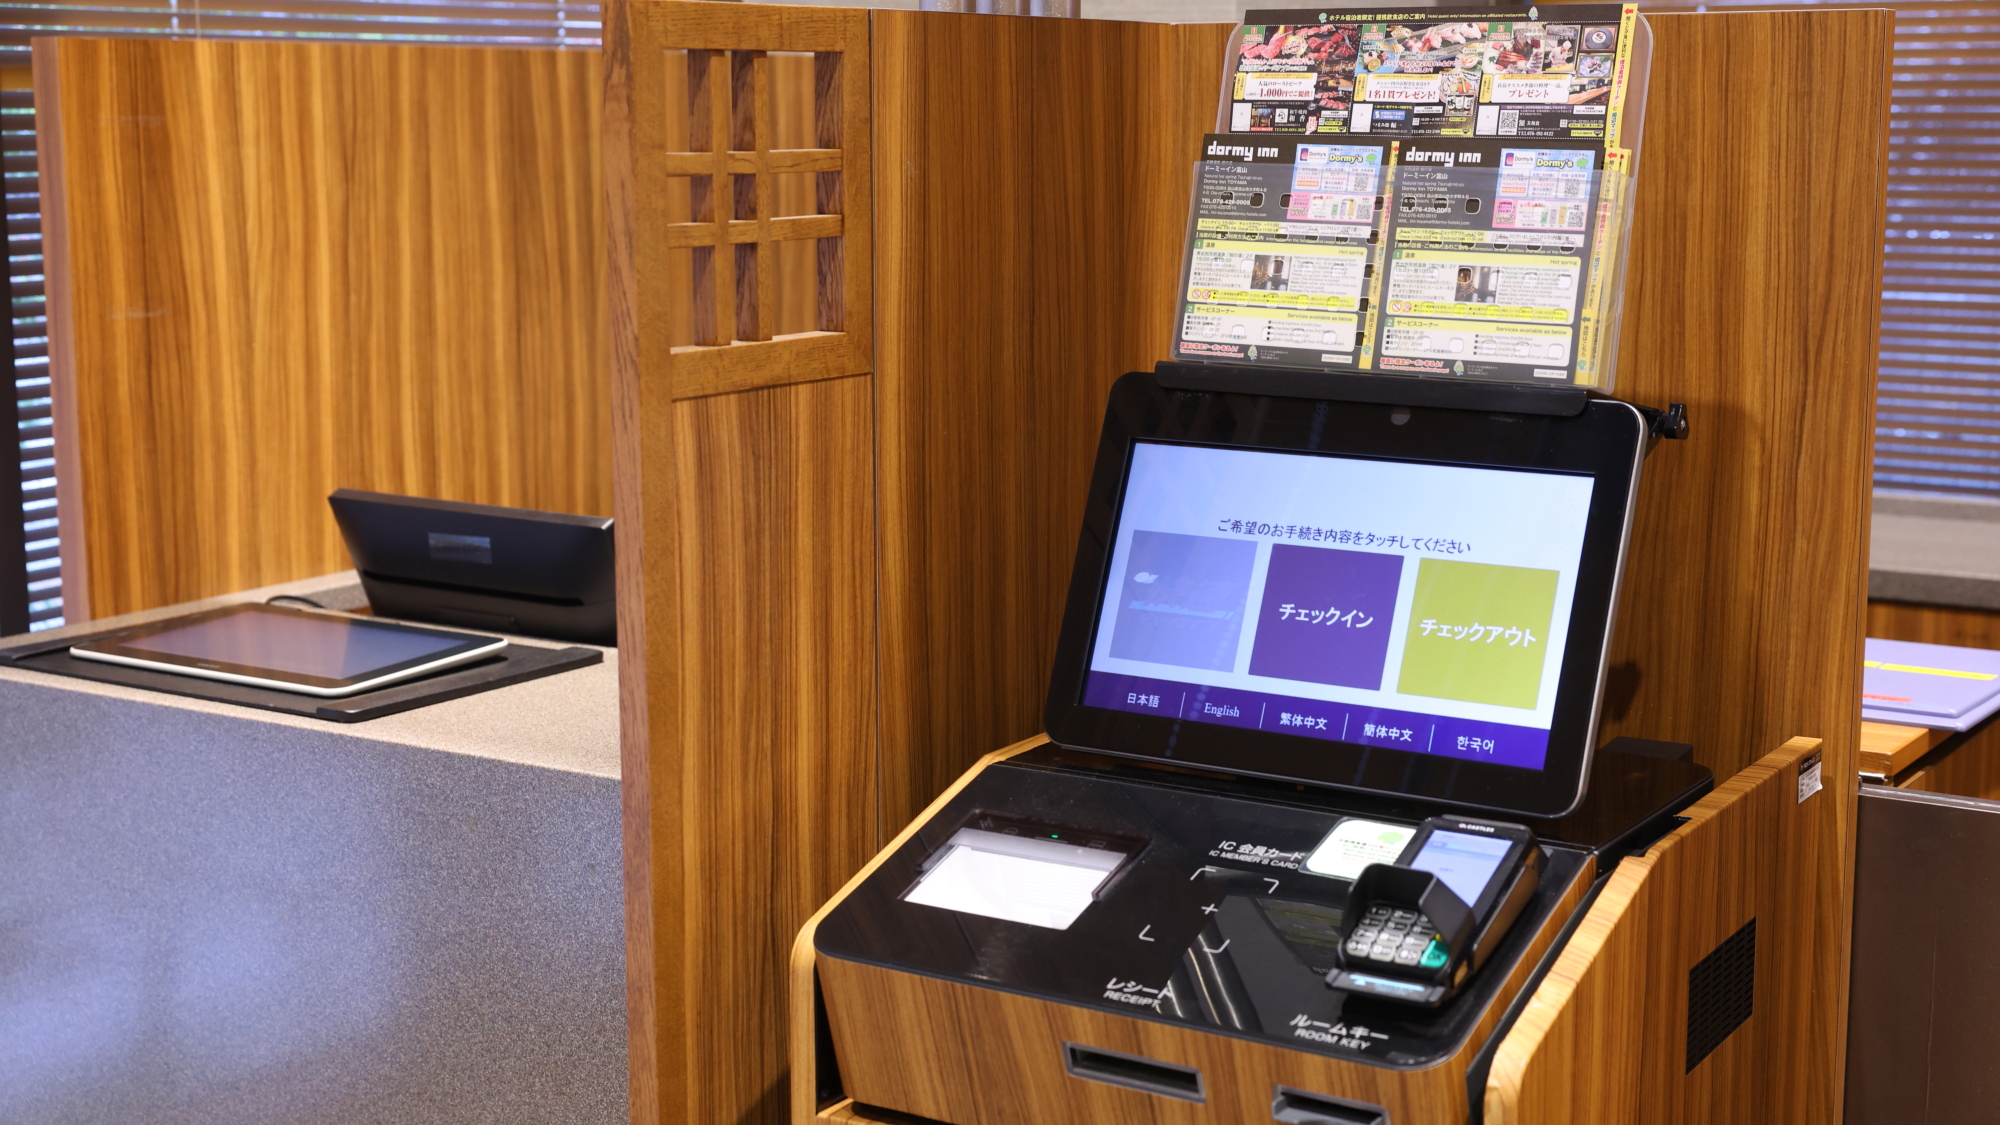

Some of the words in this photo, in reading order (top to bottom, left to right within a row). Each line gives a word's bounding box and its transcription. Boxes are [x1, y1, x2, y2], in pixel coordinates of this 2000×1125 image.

[1368, 90, 1436, 100] 1名1貫プレゼント!
[1509, 90, 1549, 98] プレゼント
[1207, 141, 1254, 161] dormy
[1329, 154, 1363, 163] Dormy's
[1406, 147, 1454, 167] dormy
[1536, 158, 1573, 168] Dormy's
[1403, 172, 1448, 180] ドーミーイン富山
[1218, 519, 1471, 554] ご希望のお手続き内容をタッチしてください
[1279, 603, 1374, 629] チェックイン
[1419, 618, 1537, 648] チェックアウト
[1127, 693, 1160, 708] 日本語
[1204, 703, 1240, 717] English
[1280, 712, 1328, 731] 繁体中文
[1364, 723, 1413, 742] 簡体中文
[1457, 735, 1495, 754] 한국어
[1218, 840, 1237, 850] IC
[1237, 844, 1305, 861] 会員カード
[1220, 852, 1270, 865] MEMBER'S
[1270, 860, 1299, 870] CARD
[1106, 977, 1173, 999] レシート
[1103, 990, 1161, 1008] RECEIPT
[1289, 1014, 1389, 1040] ルームキー
[1294, 1028, 1339, 1044] ROOM
[1339, 1037, 1371, 1050] KEY
